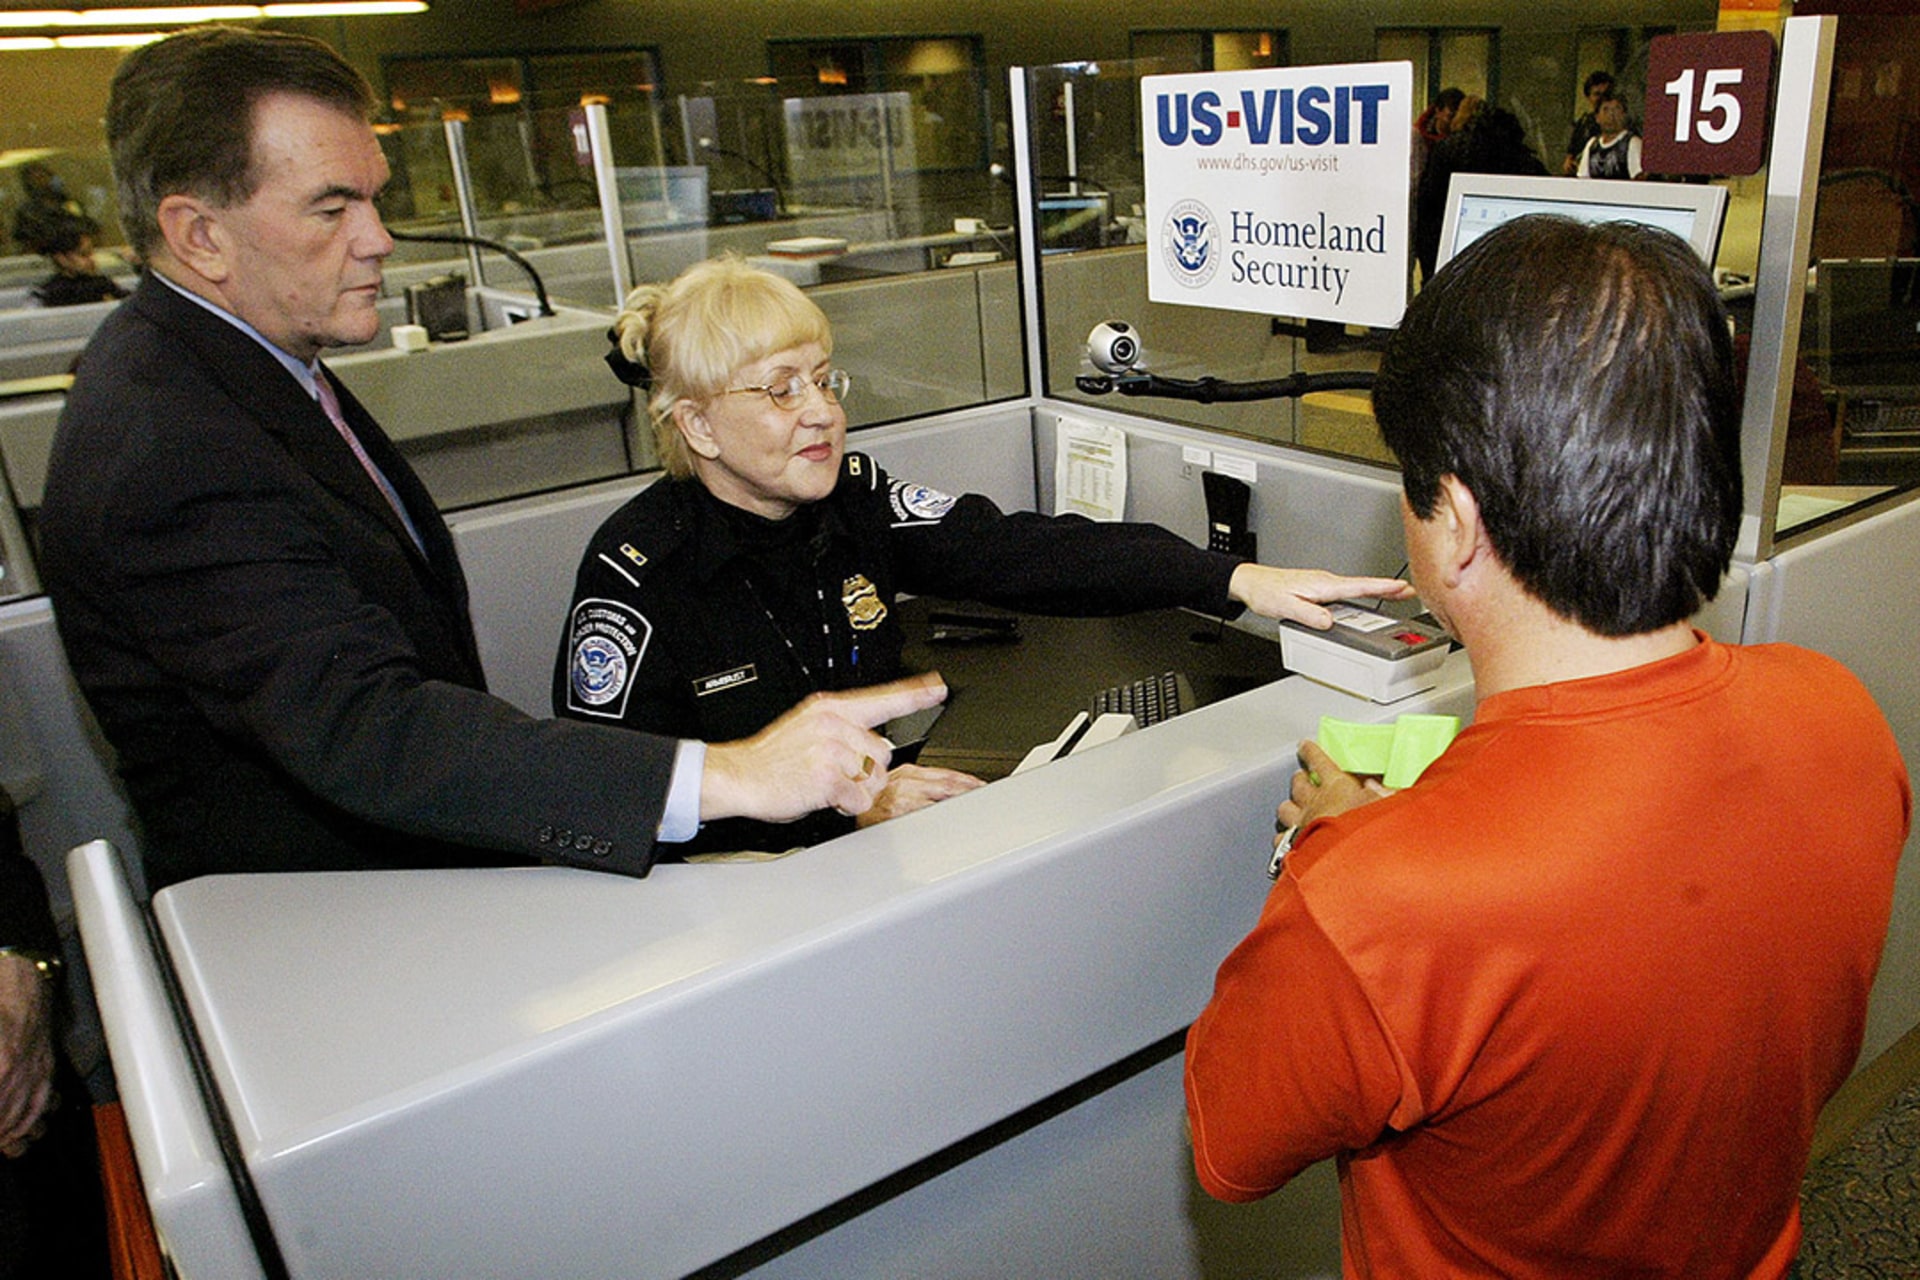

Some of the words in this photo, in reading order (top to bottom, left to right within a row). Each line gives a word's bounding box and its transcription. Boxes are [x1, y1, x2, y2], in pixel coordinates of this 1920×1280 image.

[1665, 69, 1743, 144] 15
[1197, 153, 1339, 176] www.dhs.gov/us-visit
[1230, 211, 1386, 253] Homeland
[1231, 250, 1350, 305] Security
